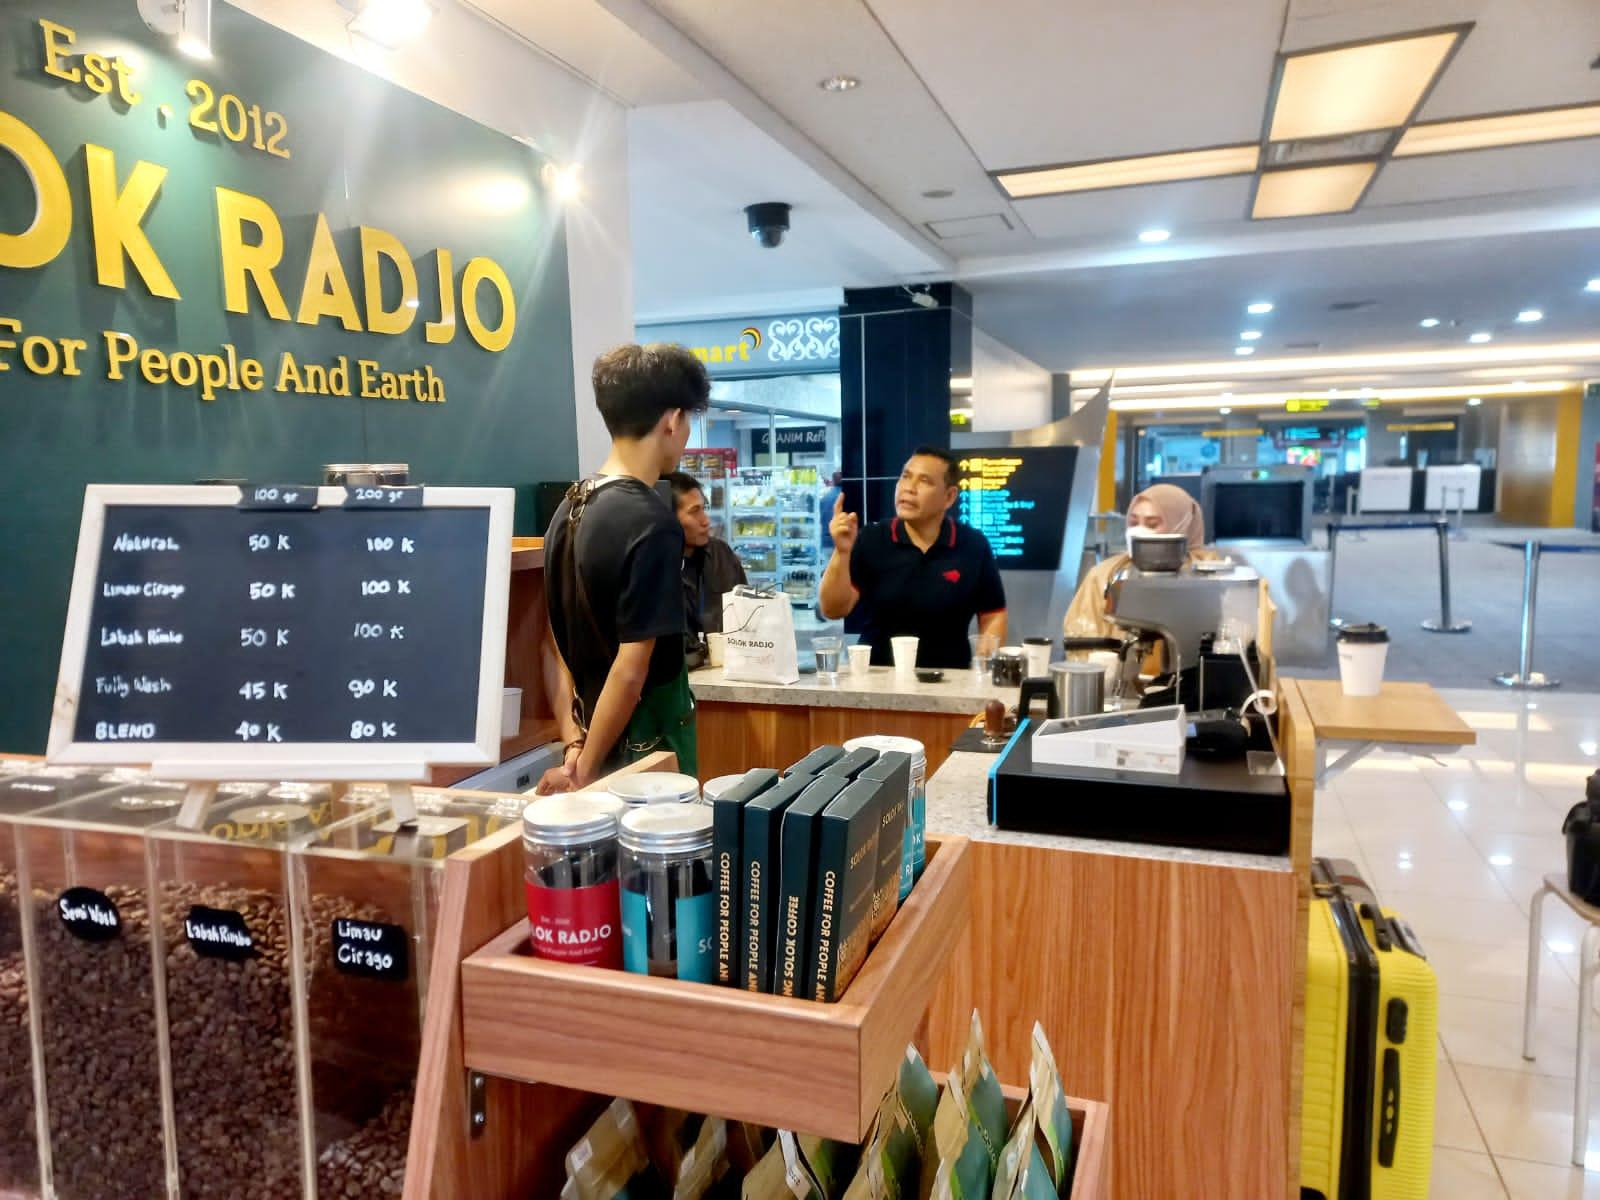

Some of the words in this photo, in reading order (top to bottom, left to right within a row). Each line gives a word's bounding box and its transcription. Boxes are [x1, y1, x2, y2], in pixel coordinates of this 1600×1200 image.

[186, 80, 290, 159] 2012
[216, 186, 516, 352] RADJO
[103, 330, 263, 401] People
[275, 351, 352, 397] And
[358, 359, 446, 402] Earth
[254, 489, 278, 502] 100
[355, 488, 383, 500] 200
[249, 534, 270, 551] 50
[277, 534, 291, 551] K
[250, 582, 276, 600] 50
[281, 583, 296, 599] K
[362, 579, 390, 596] 100
[397, 579, 412, 595] K
[240, 628, 267, 647] 50
[275, 628, 290, 647] K
[354, 622, 383, 638] 100
[748, 640, 775, 649] RADJO
[239, 680, 266, 700] 45
[273, 681, 289, 701] K
[348, 678, 376, 699] 90
[382, 678, 398, 698] K
[95, 720, 156, 741] BLEND
[234, 719, 261, 741] 40
[266, 722, 283, 743] K
[350, 719, 377, 740] 80
[381, 720, 398, 739] K
[719, 851, 730, 893] COFFEE
[750, 860, 761, 901] COFFEE
[823, 870, 836, 912] COFFEE
[719, 894, 730, 917] FOR
[749, 904, 760, 927] FOR
[787, 895, 799, 936] COFFEE
[338, 921, 382, 941] Limau
[558, 924, 611, 944] RADJO
[821, 914, 832, 938] FOR
[719, 919, 729, 960] PEOPLE
[748, 929, 759, 970] PEOPLE
[338, 945, 393, 970] Cirago
[784, 939, 796, 978] SOLOK
[817, 940, 830, 982] PEOPLE
[719, 962, 729, 981] AN
